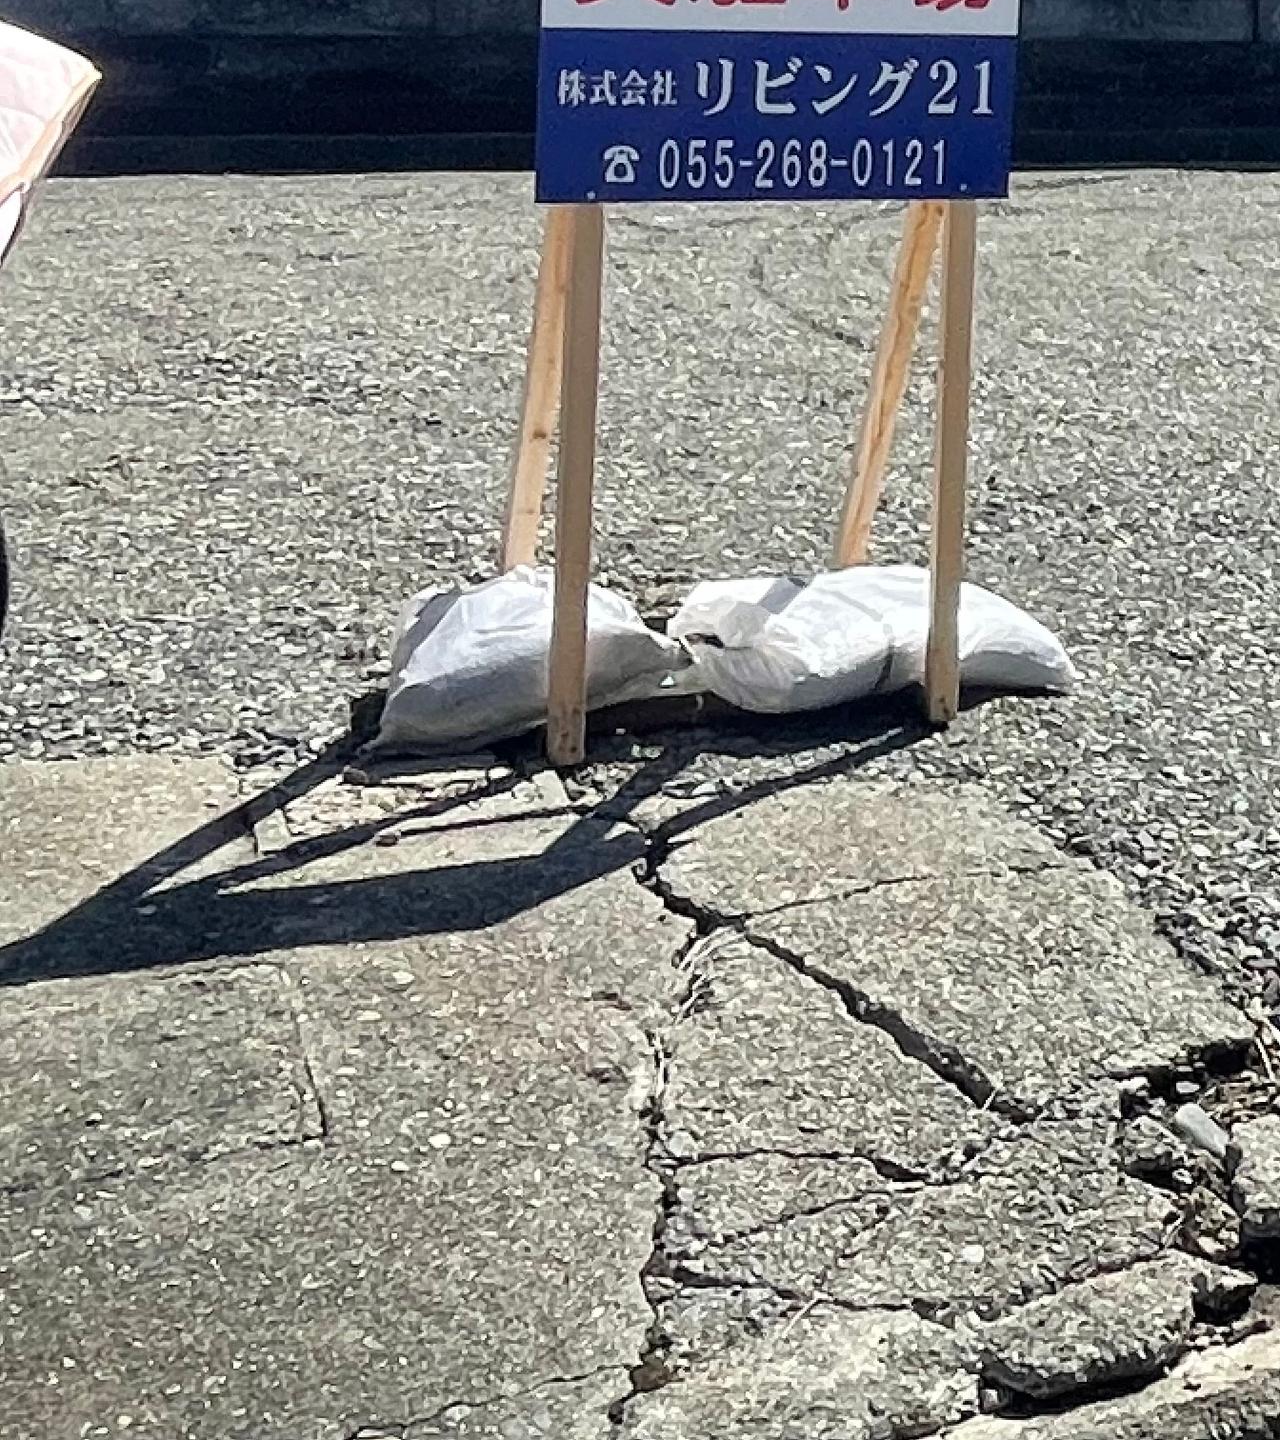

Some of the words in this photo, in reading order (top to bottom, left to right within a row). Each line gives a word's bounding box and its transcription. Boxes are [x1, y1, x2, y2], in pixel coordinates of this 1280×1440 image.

[557, 68, 679, 108] 株式会社
[694, 56, 995, 117] リビング21
[658, 138, 947, 189] 055-268-0121
